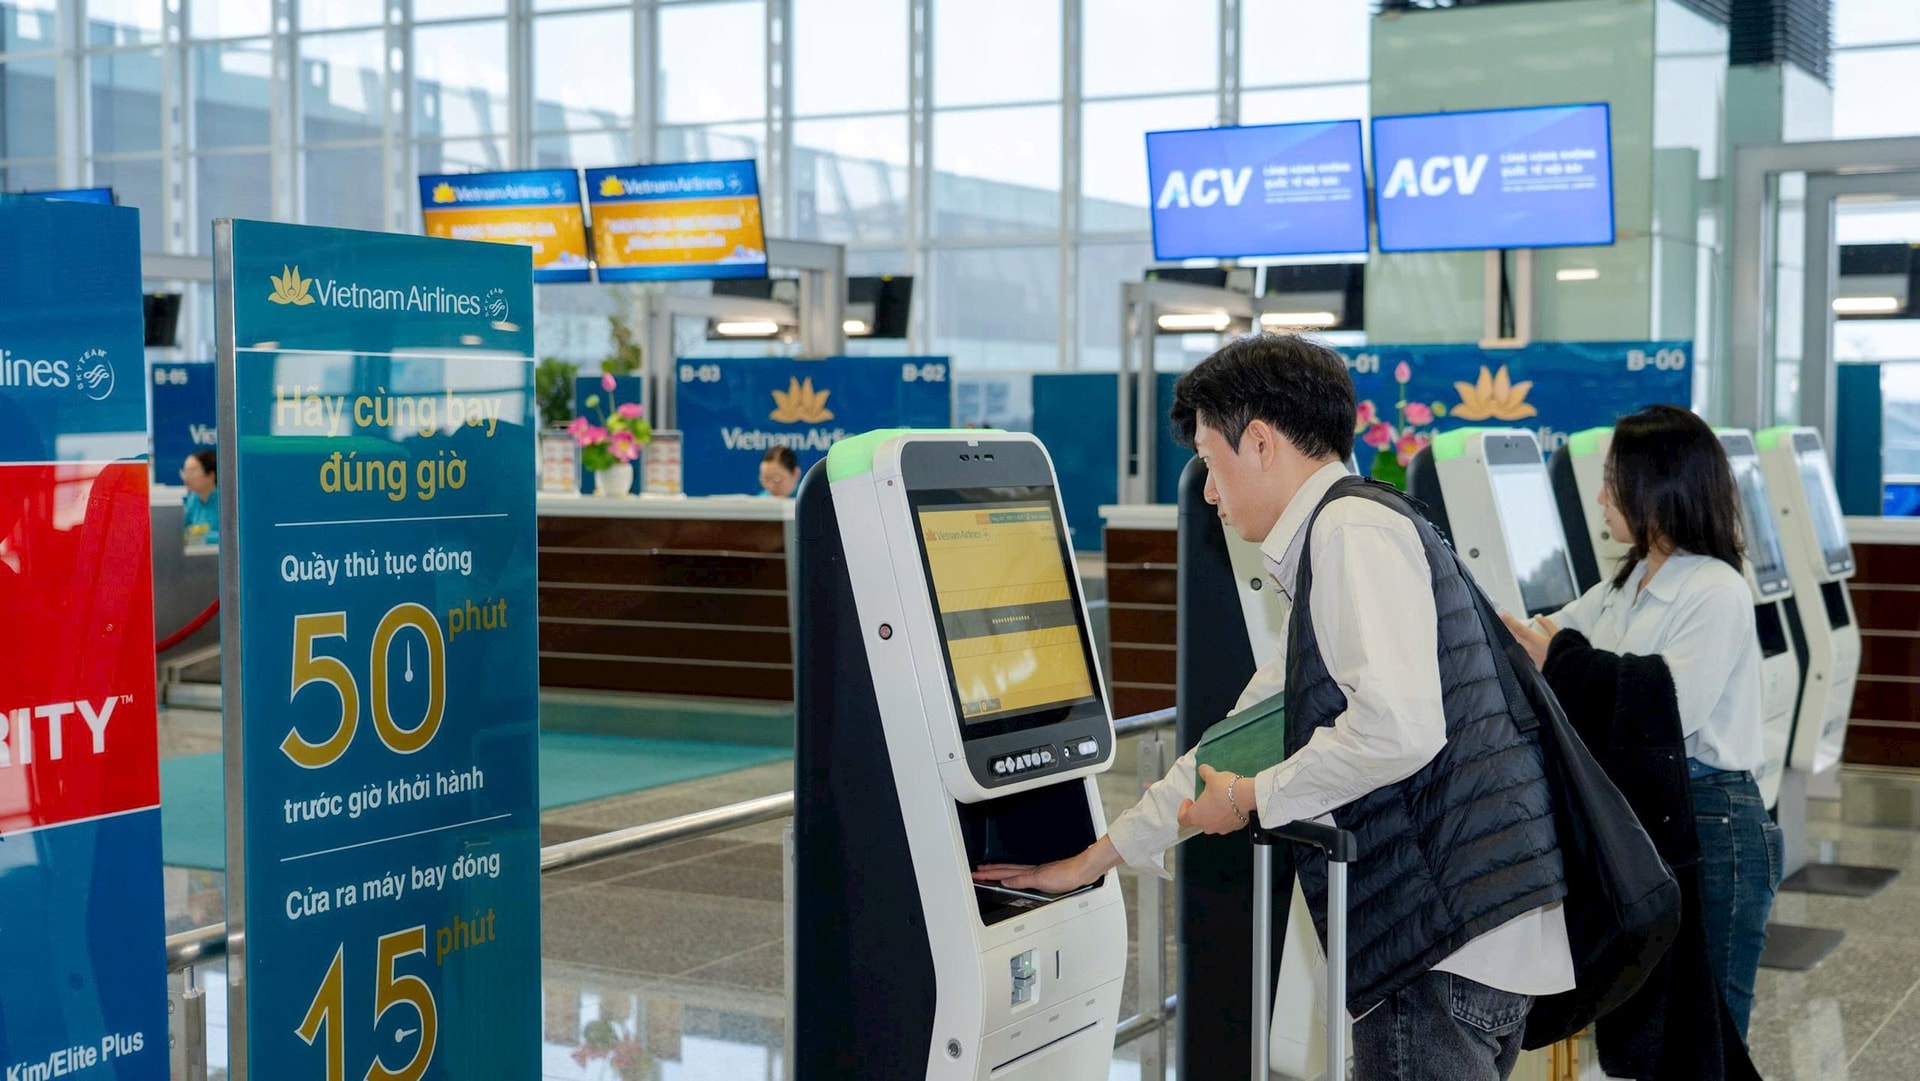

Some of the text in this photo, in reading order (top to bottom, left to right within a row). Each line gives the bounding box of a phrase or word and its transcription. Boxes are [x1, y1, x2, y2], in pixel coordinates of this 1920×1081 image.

[1158, 167, 1252, 209] ACV
[1383, 154, 1488, 199] ACV
[680, 364, 721, 383] B-03
[902, 363, 946, 382] B-02
[1626, 350, 1686, 371] B-00
[276, 384, 502, 438] Hãy cùng bay
[319, 450, 467, 501] đúng giờ
[281, 547, 472, 586] Quầy thủ tục đóng
[448, 597, 508, 642] phút
[279, 602, 446, 770] 50
[283, 765, 484, 824] trước giờ khởi hành
[285, 852, 500, 920] Cửa ra máy bay đóng
[436, 907, 496, 966] phút
[294, 924, 438, 1081] 15
[6, 1031, 144, 1081] Kim/Elite Plus
